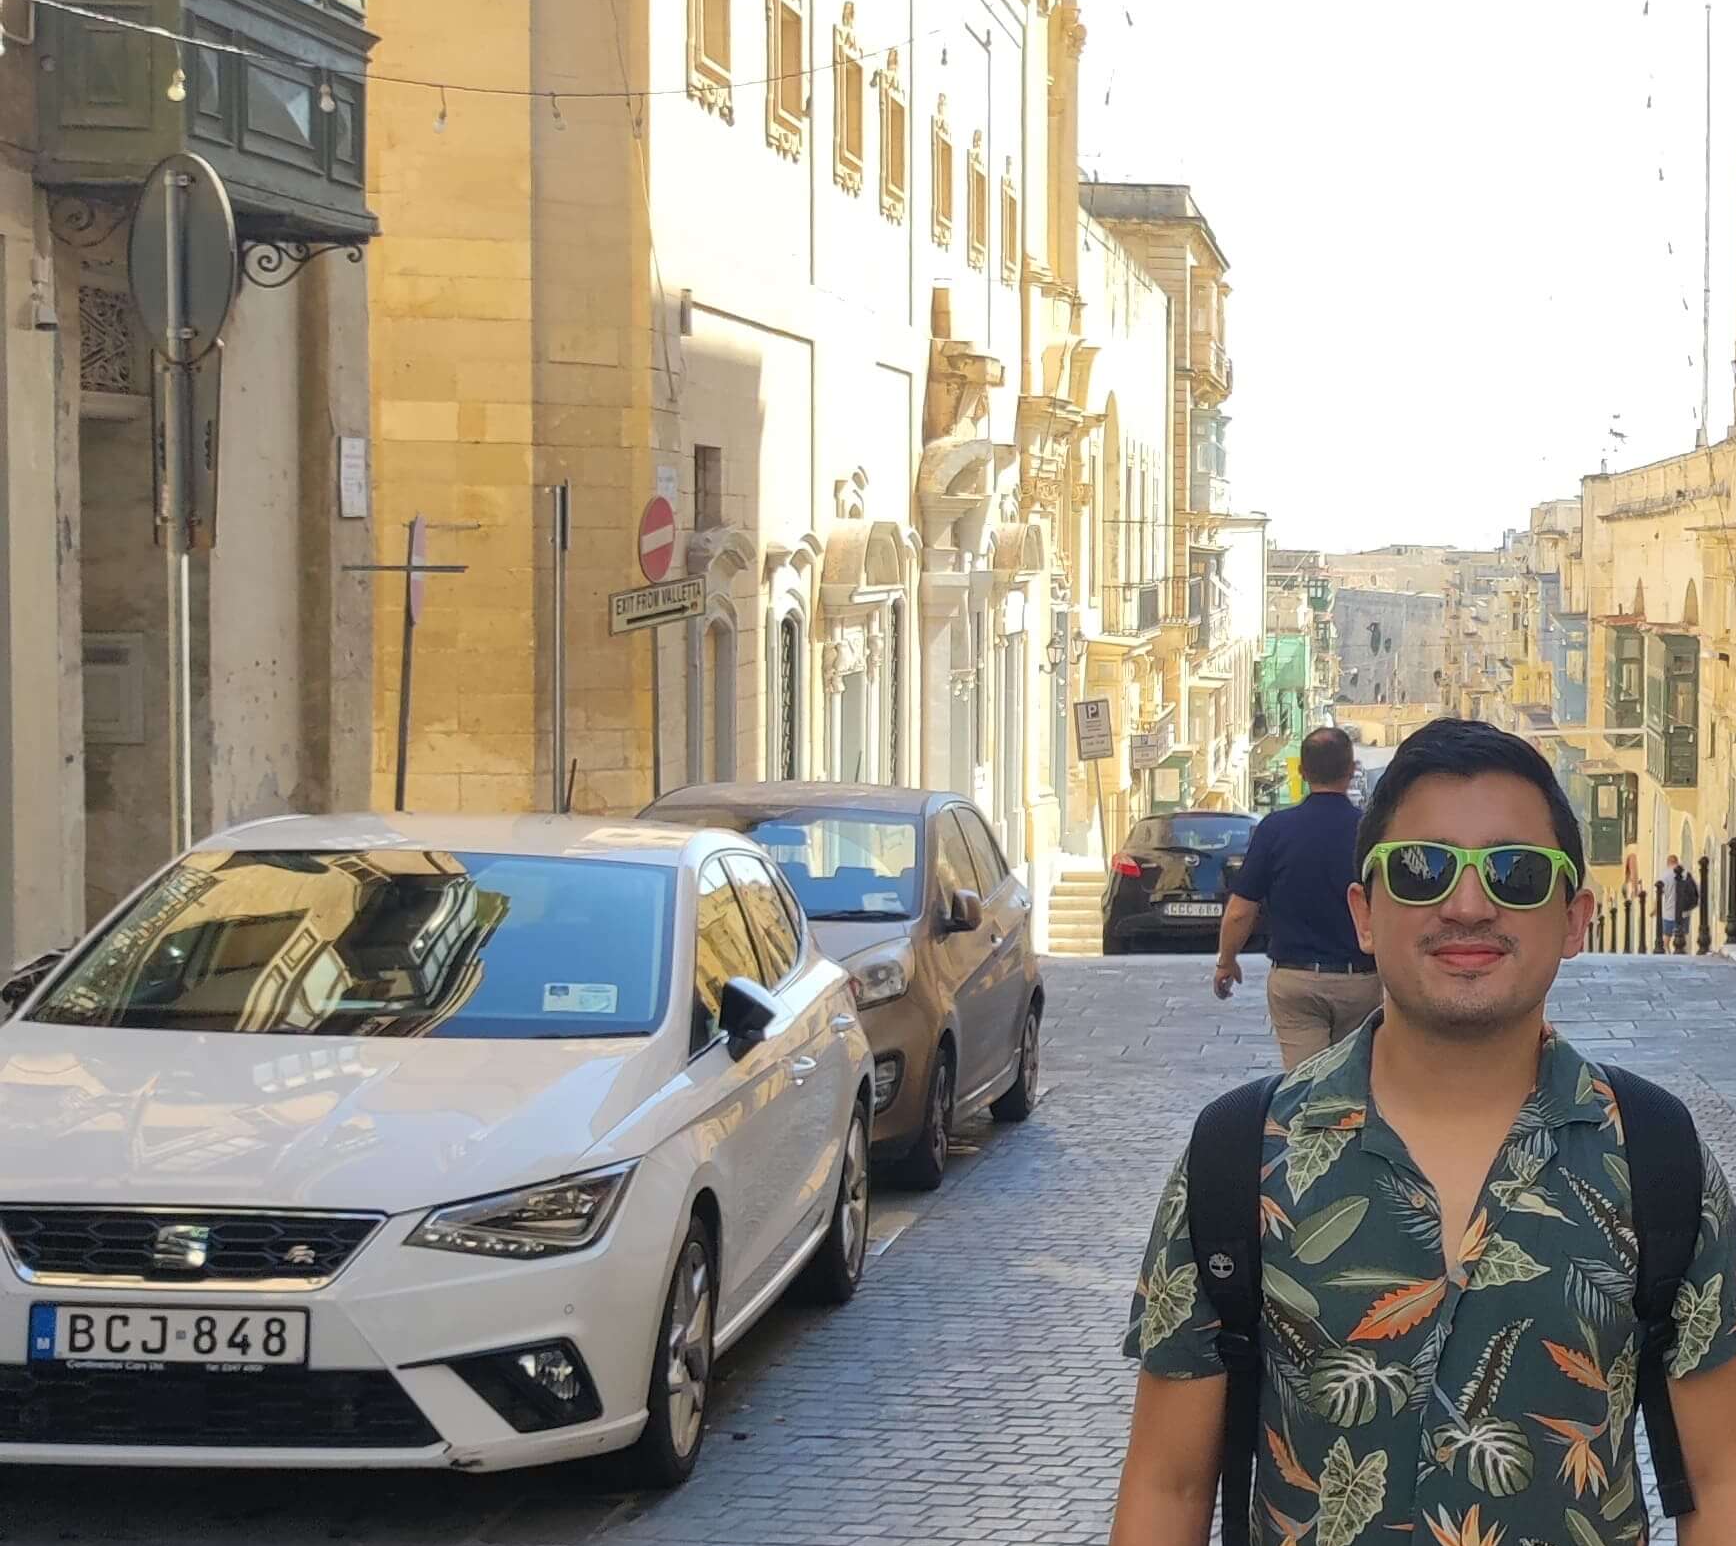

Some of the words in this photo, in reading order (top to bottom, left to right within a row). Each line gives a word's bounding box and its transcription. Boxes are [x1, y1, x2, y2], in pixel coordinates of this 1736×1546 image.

[616, 596, 635, 615] EXIT
[637, 590, 660, 612] FROM
[661, 581, 702, 605] VALLETTA
[1087, 705, 1097, 718] P
